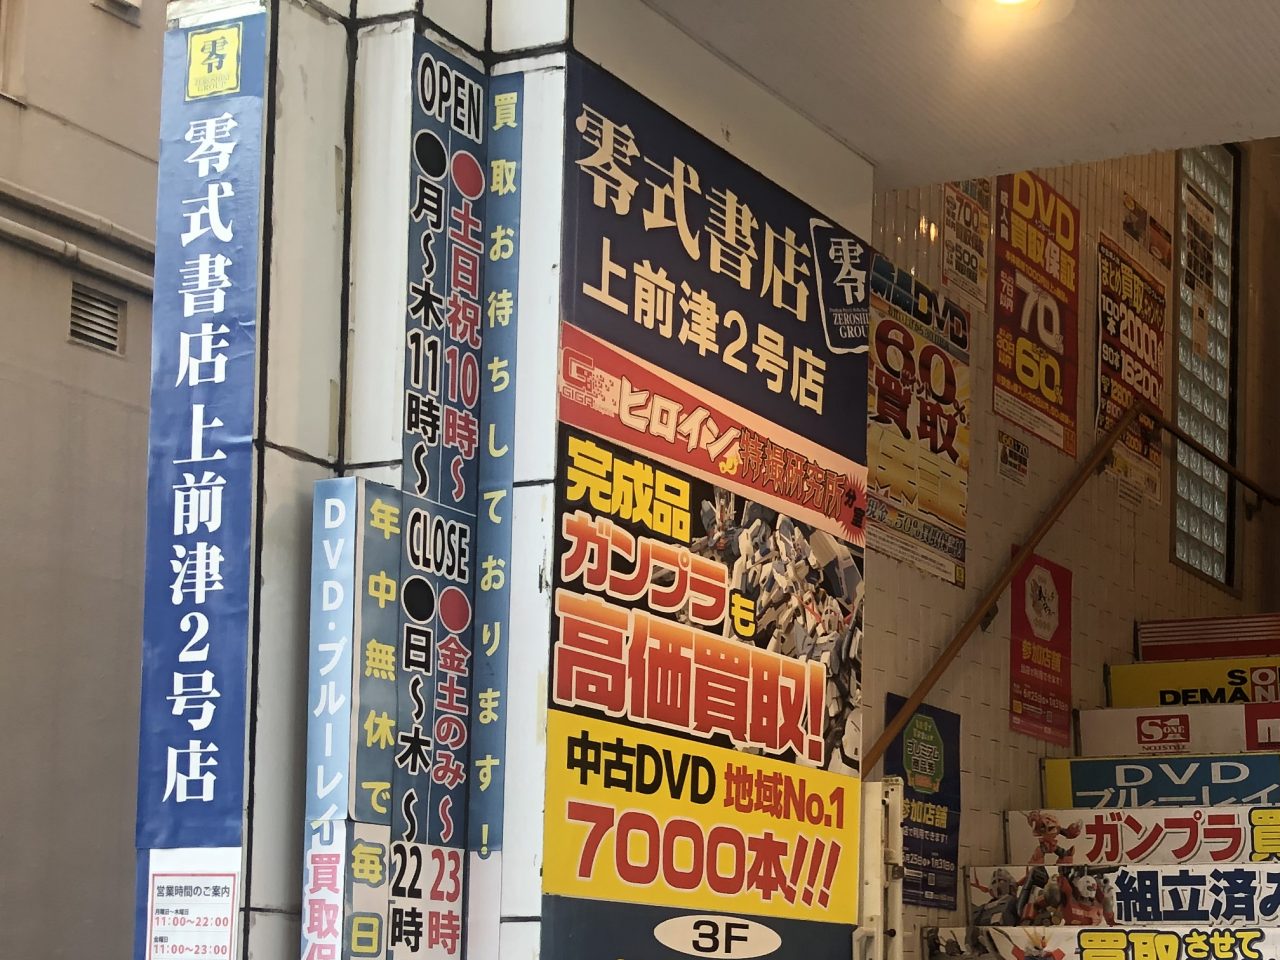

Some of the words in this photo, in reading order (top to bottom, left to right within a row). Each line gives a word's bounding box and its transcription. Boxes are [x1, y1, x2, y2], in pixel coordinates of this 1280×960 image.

[418, 53, 483, 144] OPEN
[575, 103, 811, 322] 零式書店
[1012, 171, 1075, 252] DVD
[583, 236, 827, 415] 上前津2号店
[163, 112, 238, 803] 零式書店上前津2号店
[567, 436, 691, 543] 完成品
[618, 376, 741, 462] ヒロイン
[740, 427, 848, 518] 特撮研究所
[406, 508, 470, 583] CLOSE
[553, 587, 827, 767] 高価買取!
[566, 730, 717, 805] 中古DVD
[723, 762, 845, 830] 地域No.1
[1115, 761, 1250, 787] DVD
[156, 885, 230, 898] 営業時間のご案内
[566, 800, 842, 909] 7000本!!!
[691, 919, 750, 954] 3F
[1184, 928, 1264, 960] させて
